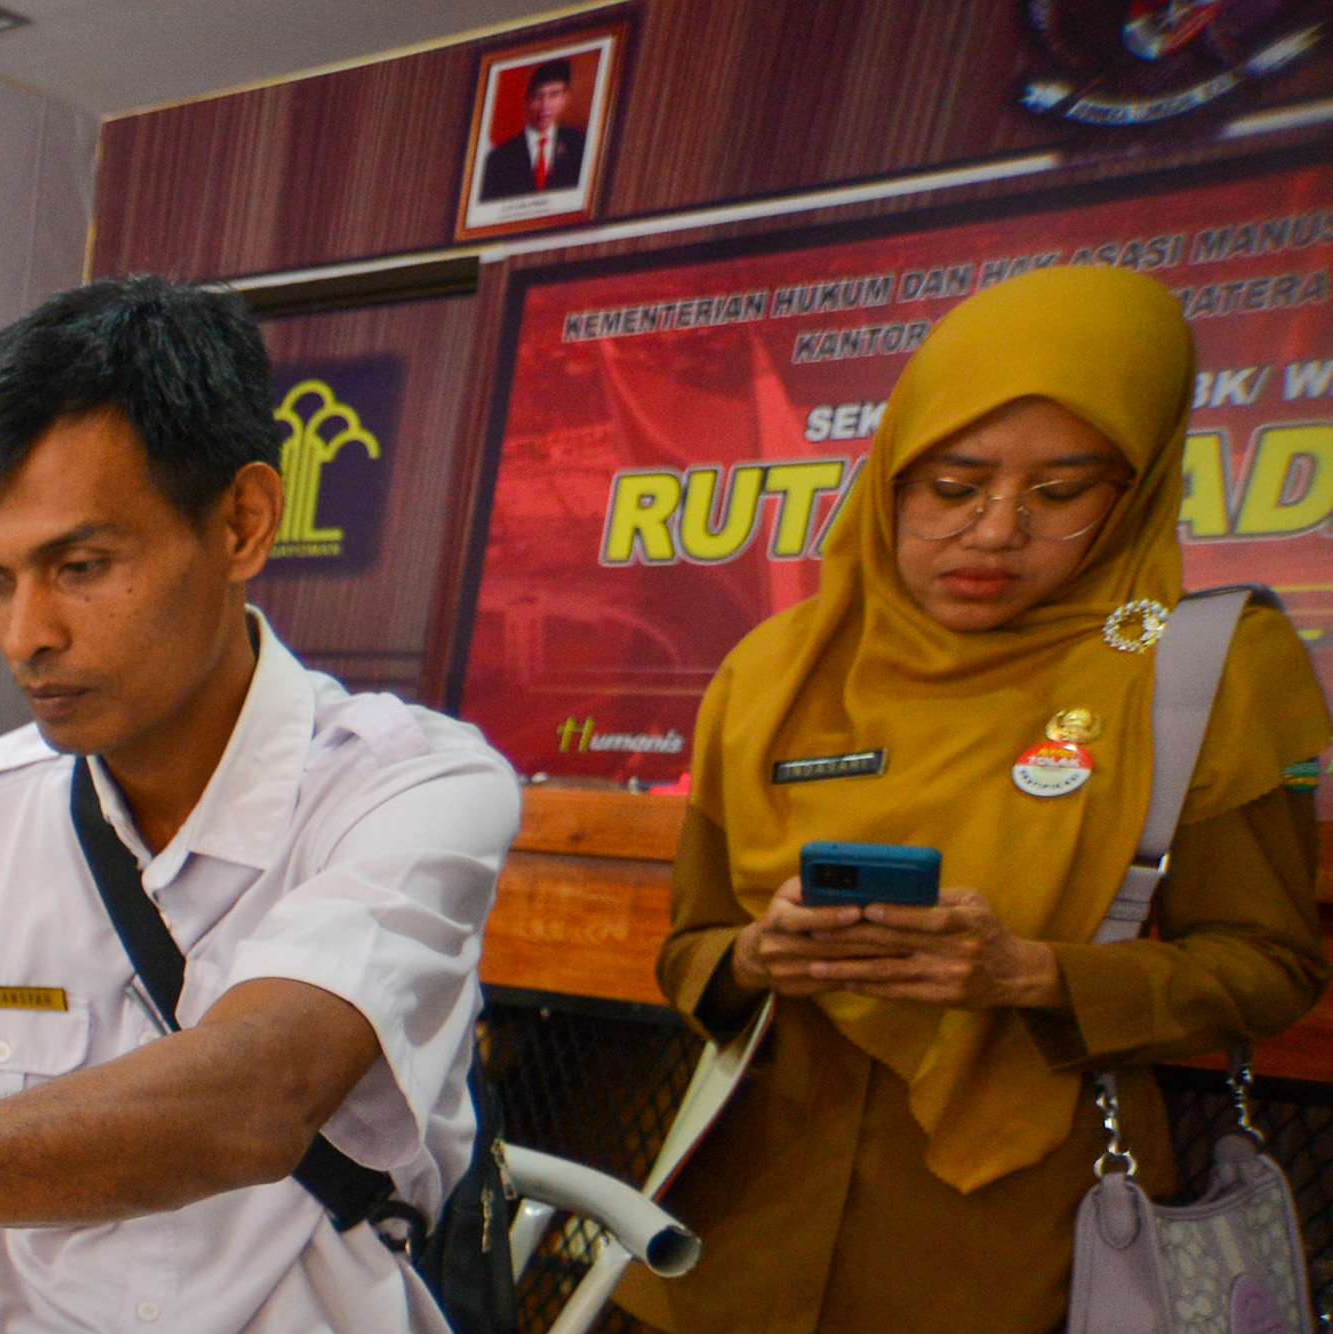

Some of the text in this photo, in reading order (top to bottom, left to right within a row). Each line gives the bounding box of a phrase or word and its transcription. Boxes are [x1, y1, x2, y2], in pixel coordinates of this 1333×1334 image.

[563, 290, 769, 343] KEMENTERIAN
[770, 273, 895, 319] HUKUM
[896, 263, 975, 303] DAN
[1070, 235, 1184, 272] ASASI
[792, 319, 932, 364] KANTOR
[599, 417, 1333, 567] RUT AD
[557, 716, 684, 754] Humanis
